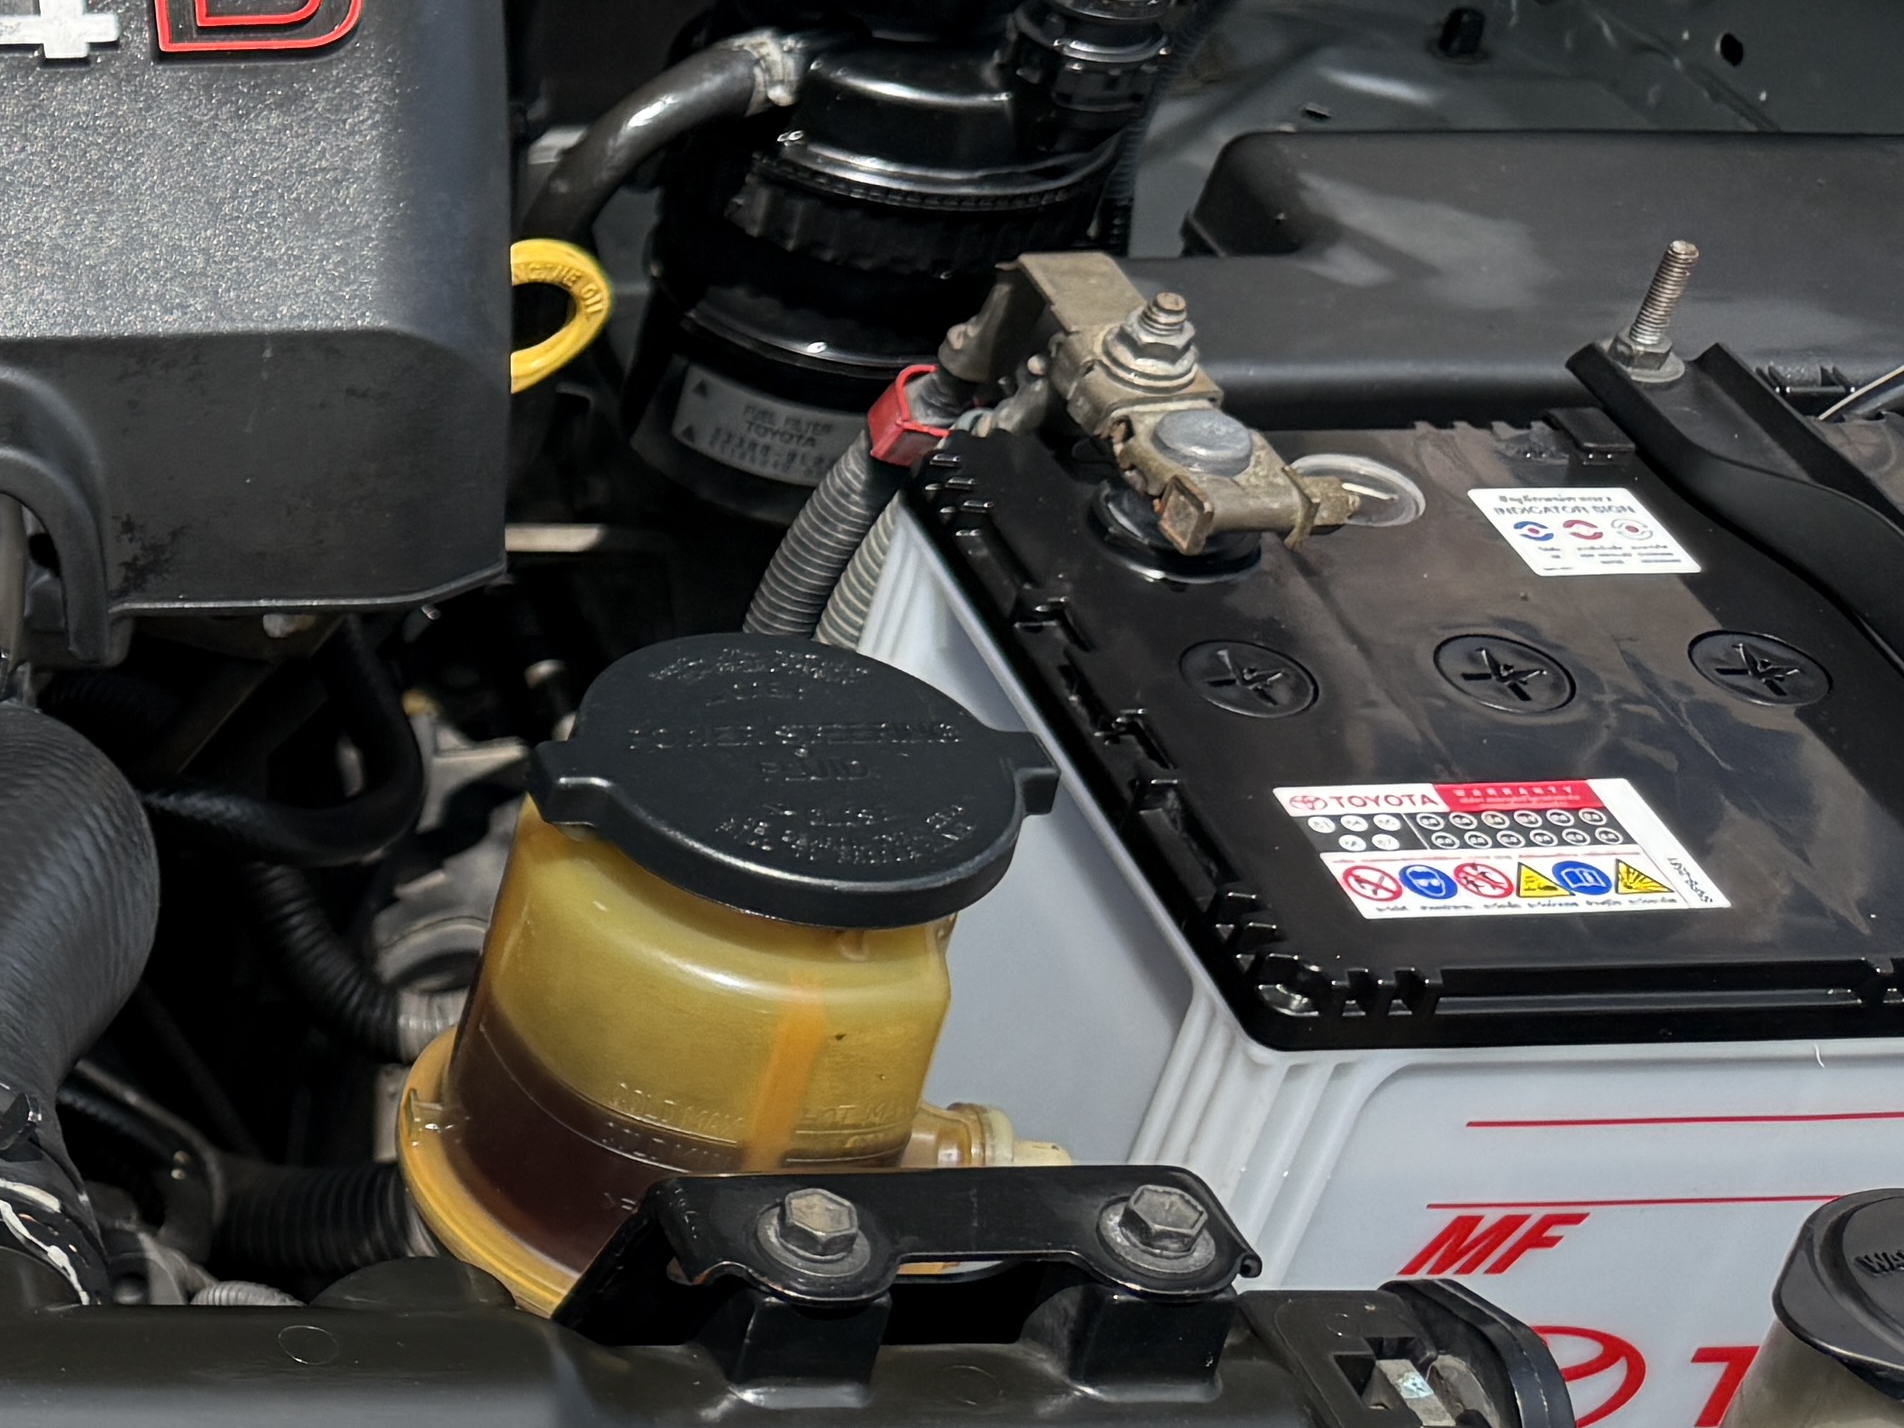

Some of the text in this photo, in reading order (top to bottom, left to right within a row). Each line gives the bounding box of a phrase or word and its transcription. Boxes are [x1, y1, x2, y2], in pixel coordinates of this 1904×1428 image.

[745, 420, 817, 448] TOYOTA
[1327, 793, 1439, 809] TOYOTA
[1397, 1211, 1591, 1276] MF
